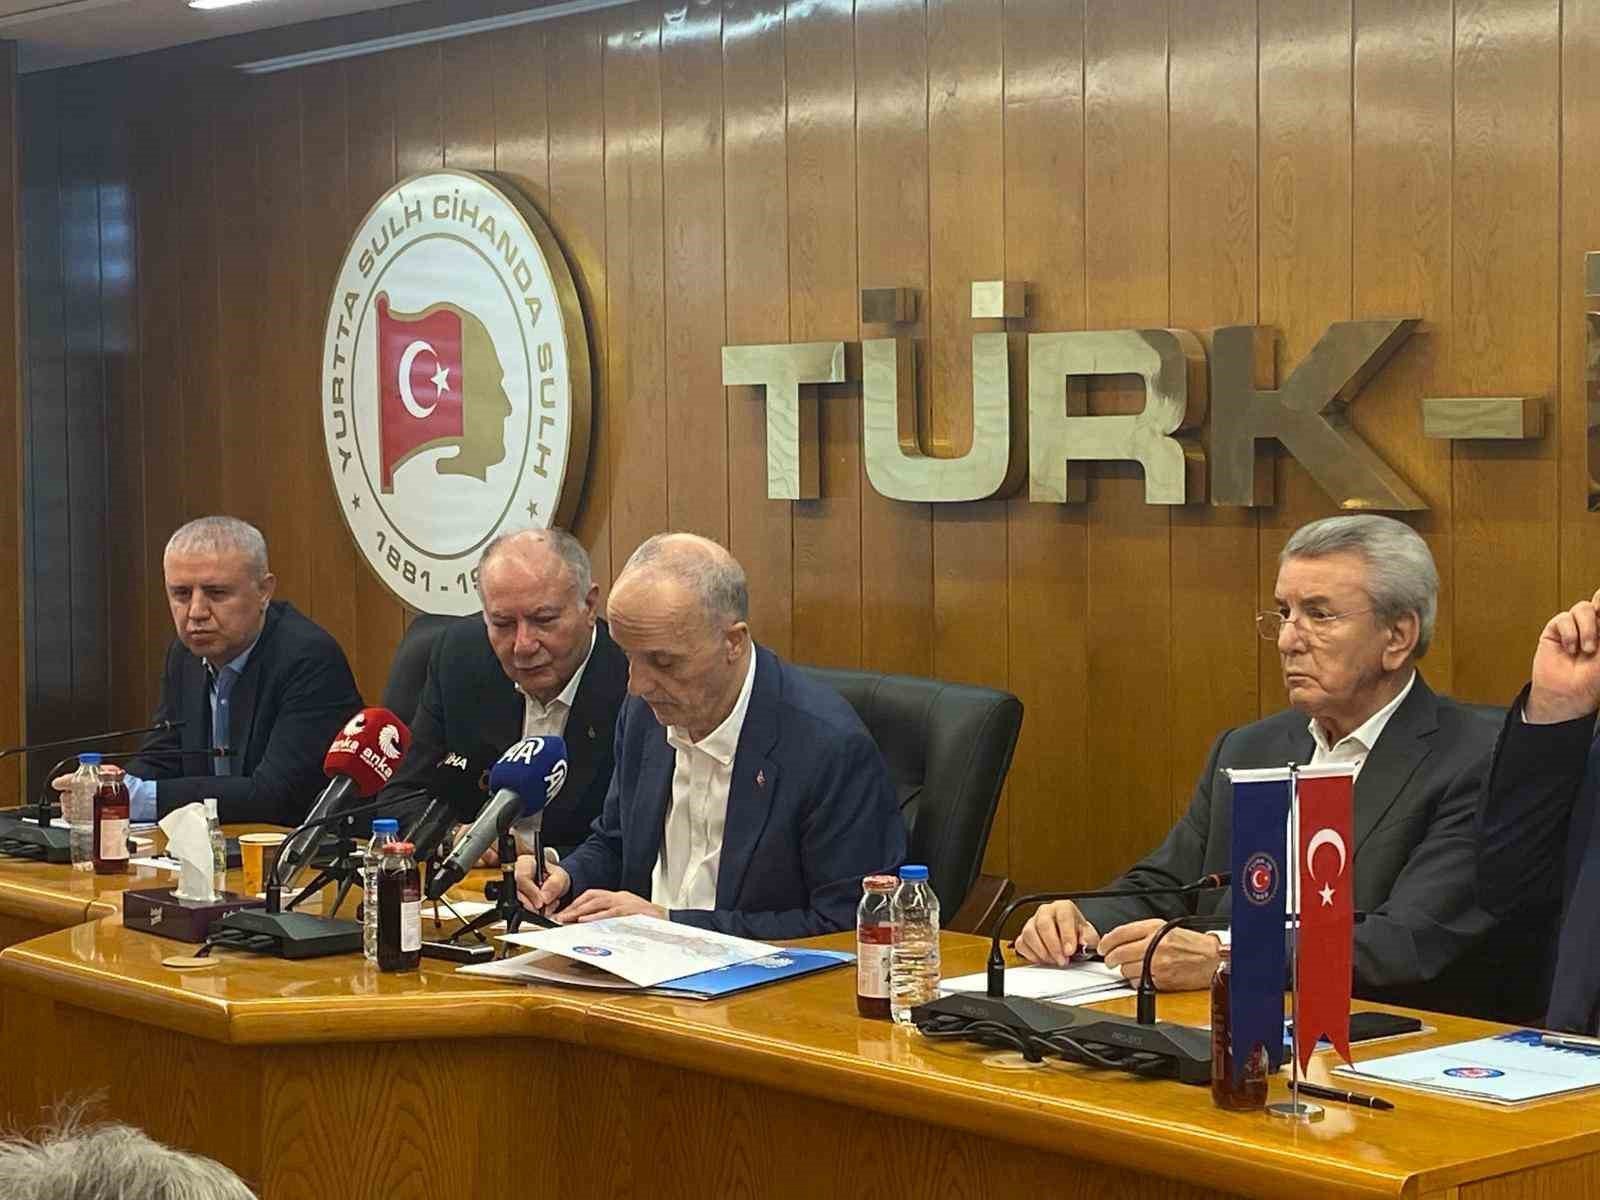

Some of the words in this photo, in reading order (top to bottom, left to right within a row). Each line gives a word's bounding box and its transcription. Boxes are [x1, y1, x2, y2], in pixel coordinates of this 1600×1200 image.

[332, 290, 360, 474] YURTTA
[358, 199, 423, 279] SULH
[432, 188, 542, 329] CİHANDA
[533, 341, 556, 479] SULH
[362, 747, 393, 778] anka
